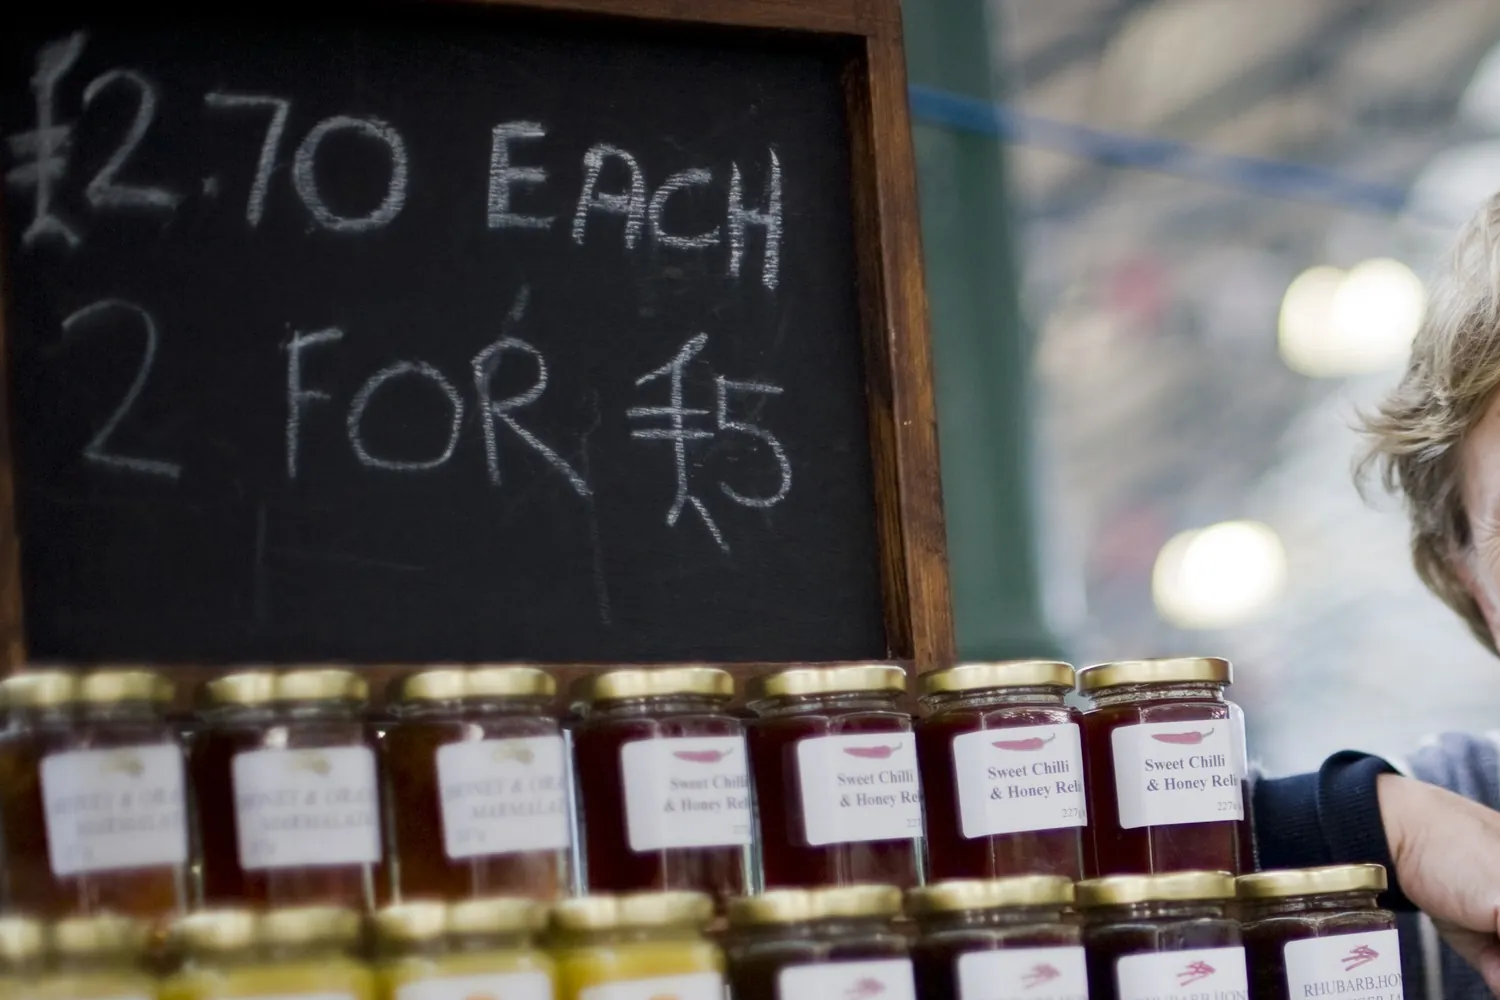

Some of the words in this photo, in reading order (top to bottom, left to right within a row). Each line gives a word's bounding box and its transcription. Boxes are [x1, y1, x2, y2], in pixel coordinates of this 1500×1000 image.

[5, 30, 408, 248] £2.70
[487, 121, 784, 290] EACH
[61, 298, 183, 480] 2
[283, 327, 593, 496] FOR
[625, 332, 793, 553] £5
[987, 766, 1028, 780] Sweet
[1031, 760, 1070, 776] Chilli
[1144, 758, 1185, 772] Sweet
[1189, 754, 1226, 769] Chilli
[669, 777, 709, 791] Sweet
[837, 773, 875, 786] Sweet
[878, 769, 914, 784] Chilli
[1146, 778, 1159, 792] &
[1164, 777, 1208, 792] Honey
[839, 796, 851, 808] &
[856, 792, 897, 808] Honey
[990, 788, 1003, 800] &
[1008, 785, 1052, 799] Honey
[663, 798, 676, 812] &
[681, 799, 721, 813] Honey
